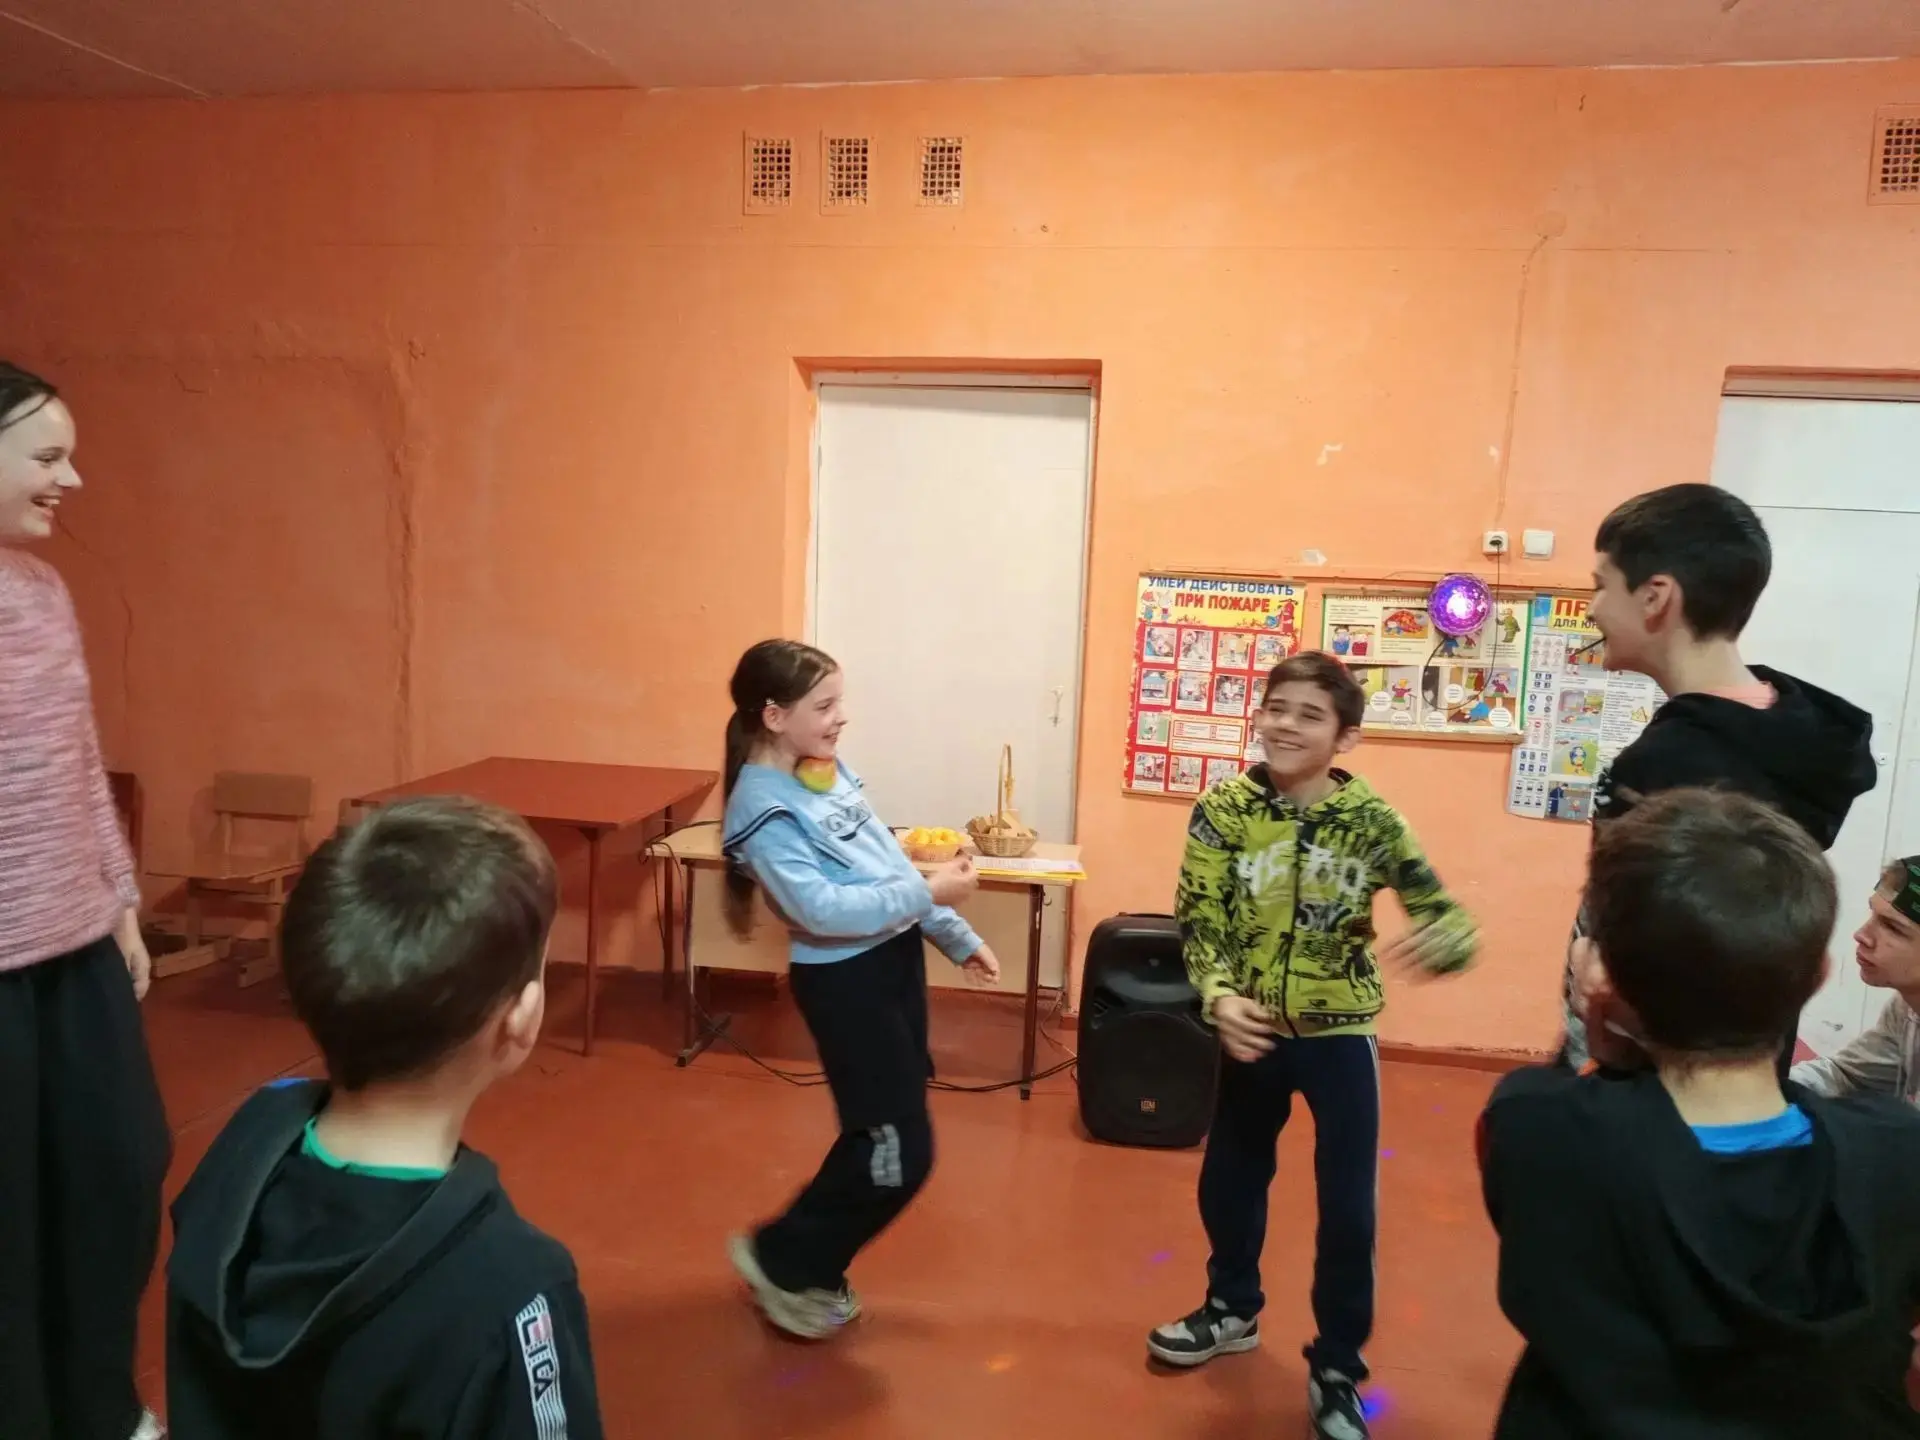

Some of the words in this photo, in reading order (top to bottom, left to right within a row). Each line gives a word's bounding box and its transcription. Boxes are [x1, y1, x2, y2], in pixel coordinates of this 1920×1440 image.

[1148, 576, 1186, 589] УМЕЙ
[1189, 579, 1294, 596] ДЕЙСТВОВАТЬ
[1174, 592, 1204, 609] ПРИ
[1208, 595, 1271, 612] ПОЖАРЕ
[1553, 618, 1577, 628] ДЛЯ
